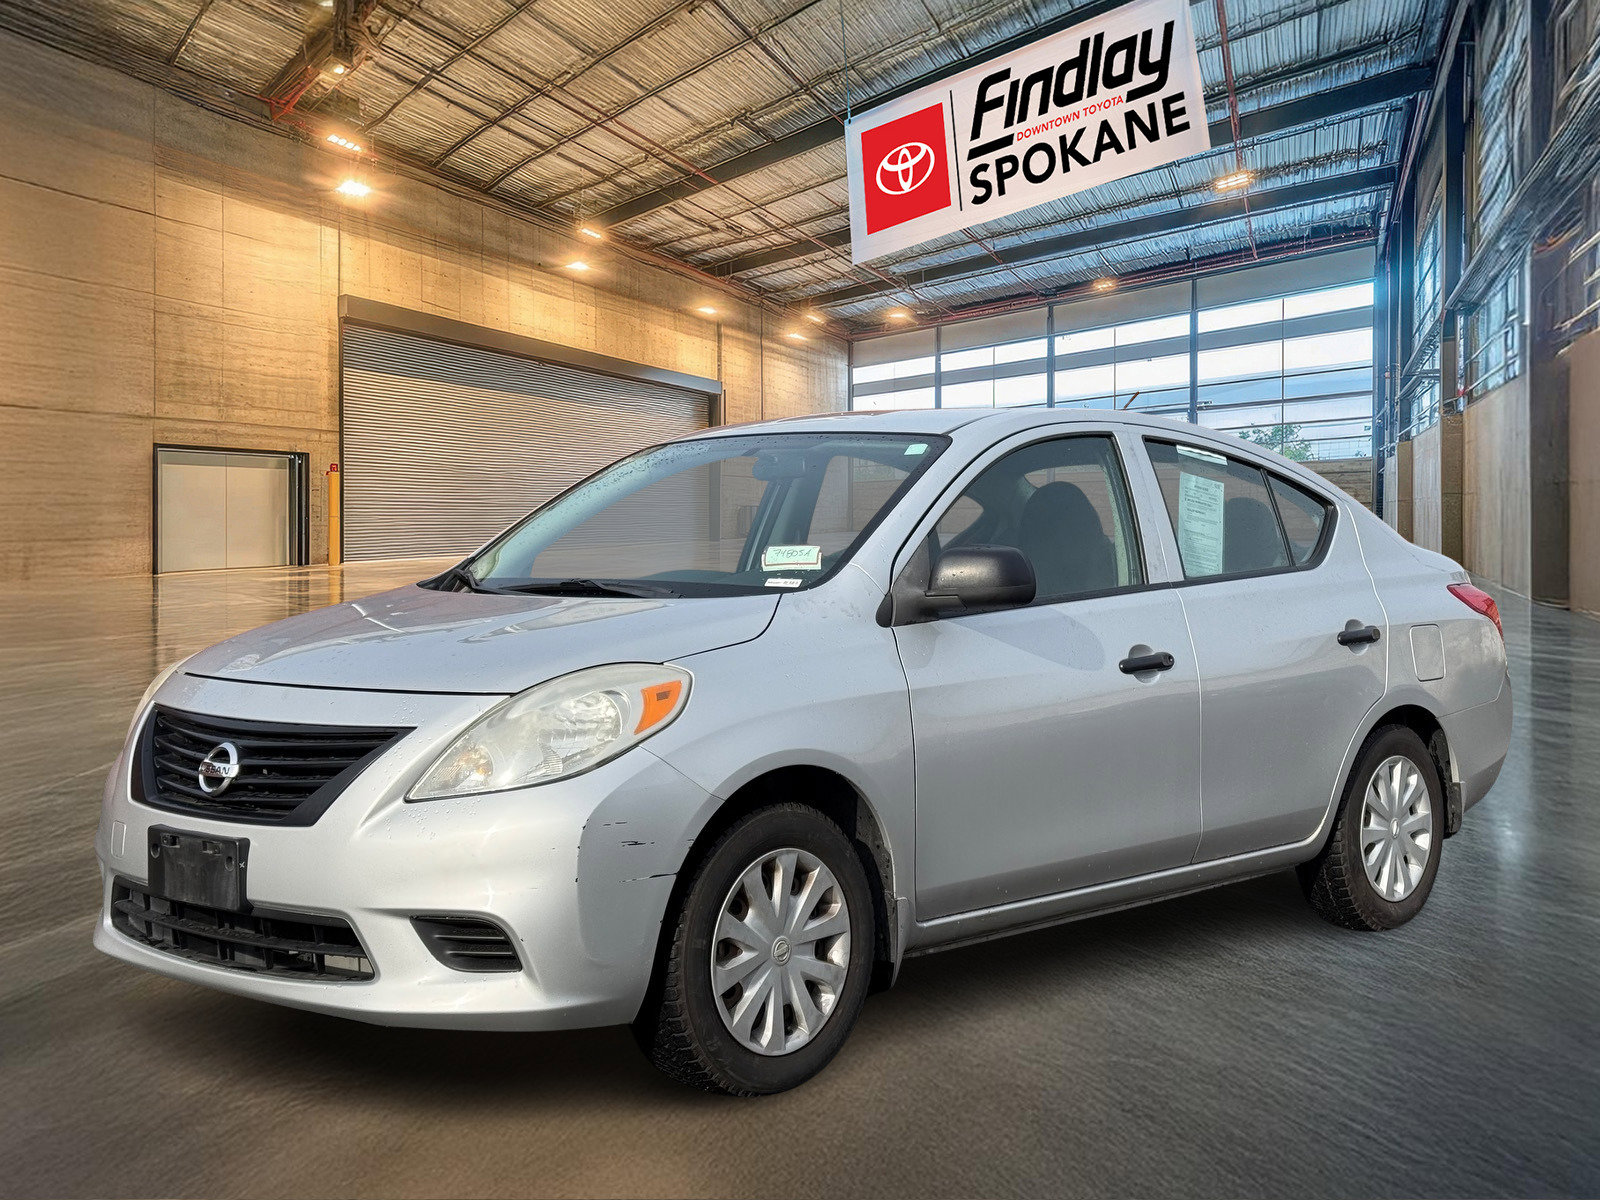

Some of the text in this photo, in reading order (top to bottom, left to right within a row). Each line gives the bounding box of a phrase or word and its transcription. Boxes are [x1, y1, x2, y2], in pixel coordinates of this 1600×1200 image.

[970, 20, 1175, 142] Findlay
[1016, 95, 1124, 142] DOWNTOWN TOYOTA
[968, 91, 1191, 206] SPOKANE
